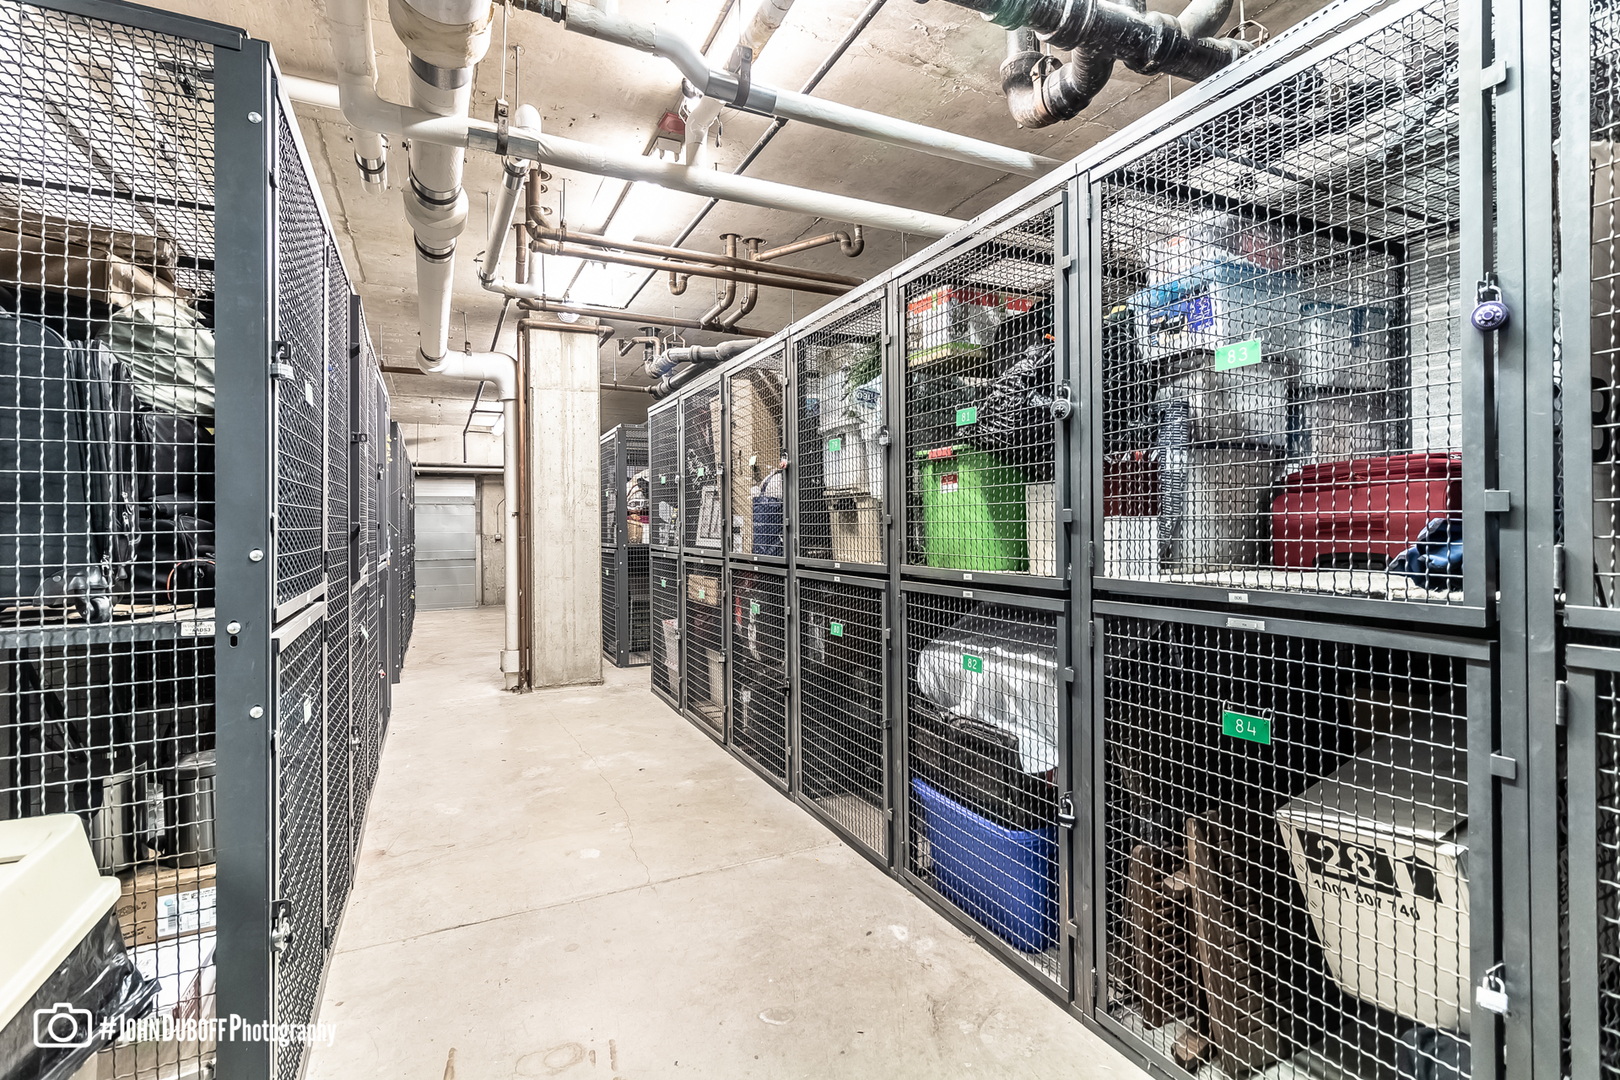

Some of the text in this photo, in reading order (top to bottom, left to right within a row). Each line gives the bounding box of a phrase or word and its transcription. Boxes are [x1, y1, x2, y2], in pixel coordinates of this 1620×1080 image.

[1227, 347, 1248, 364] 83
[961, 412, 970, 422] 81
[967, 658, 977, 670] 82
[1235, 718, 1256, 736] 84
[1317, 839, 1376, 884] 28
